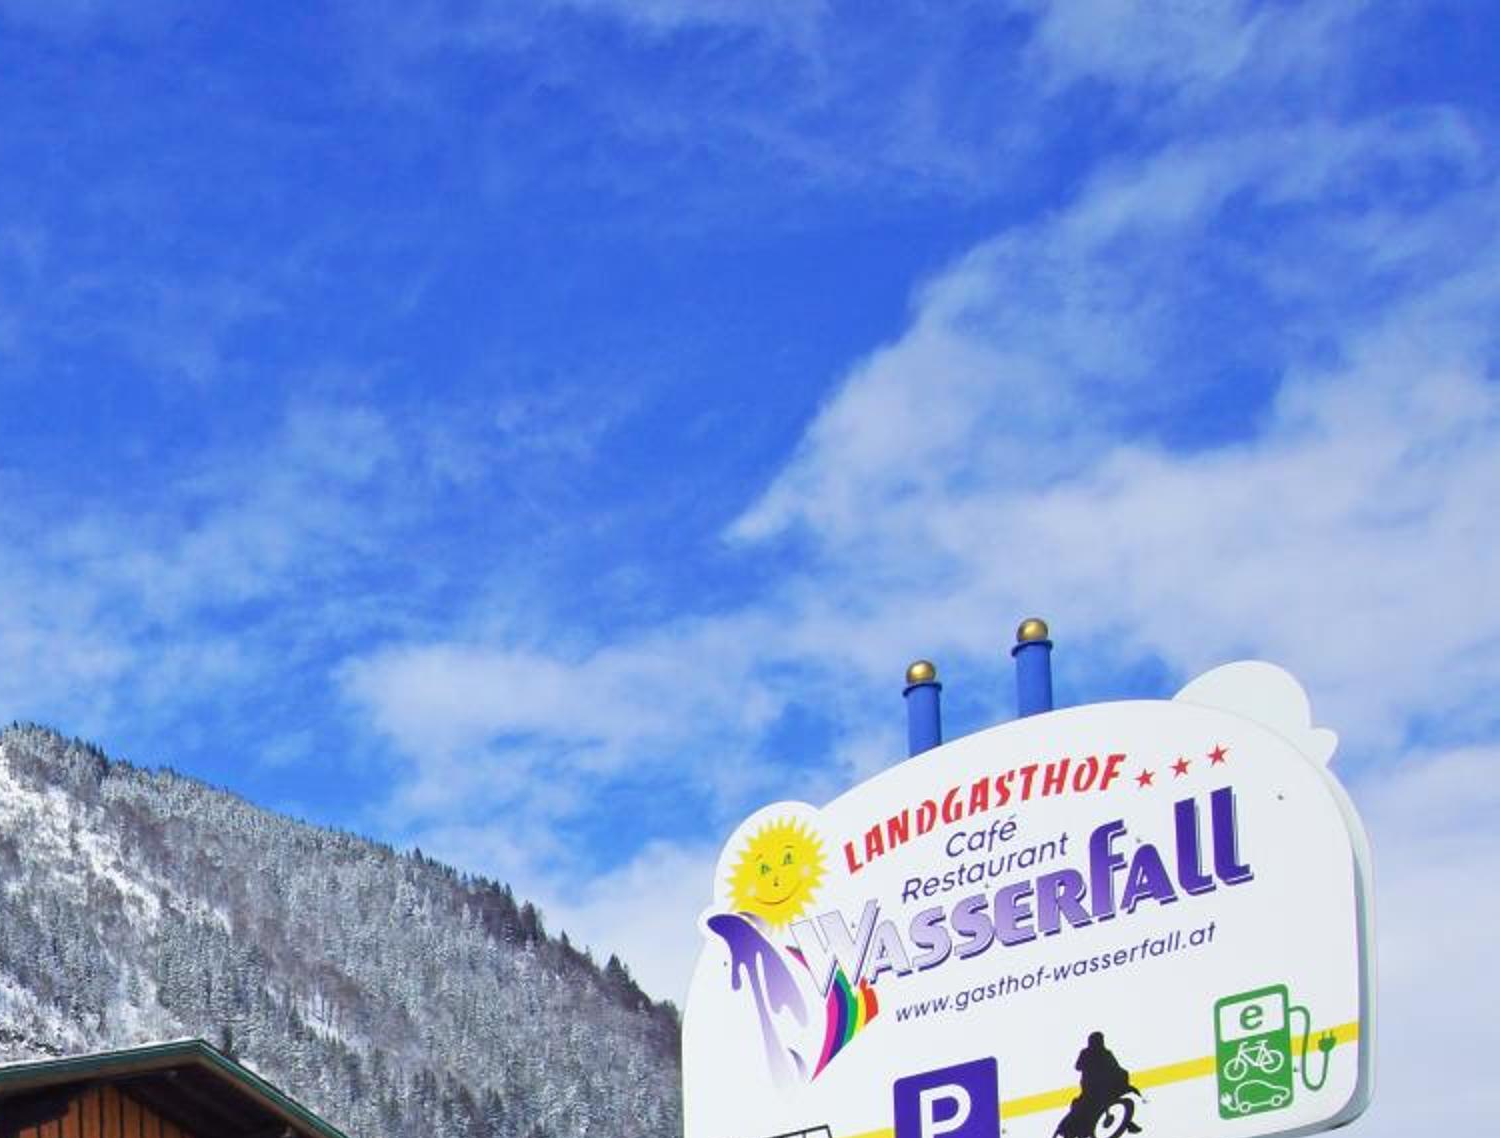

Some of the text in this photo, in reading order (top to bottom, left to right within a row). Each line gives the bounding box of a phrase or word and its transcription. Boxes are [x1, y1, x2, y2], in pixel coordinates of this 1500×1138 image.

[844, 754, 1127, 874] LANDGASTHOF
[945, 814, 1018, 857] Café
[902, 832, 1069, 904] Restaurant
[895, 921, 1216, 1022] www.gasthof-wasserfall.at
[1239, 1004, 1264, 1030] e
